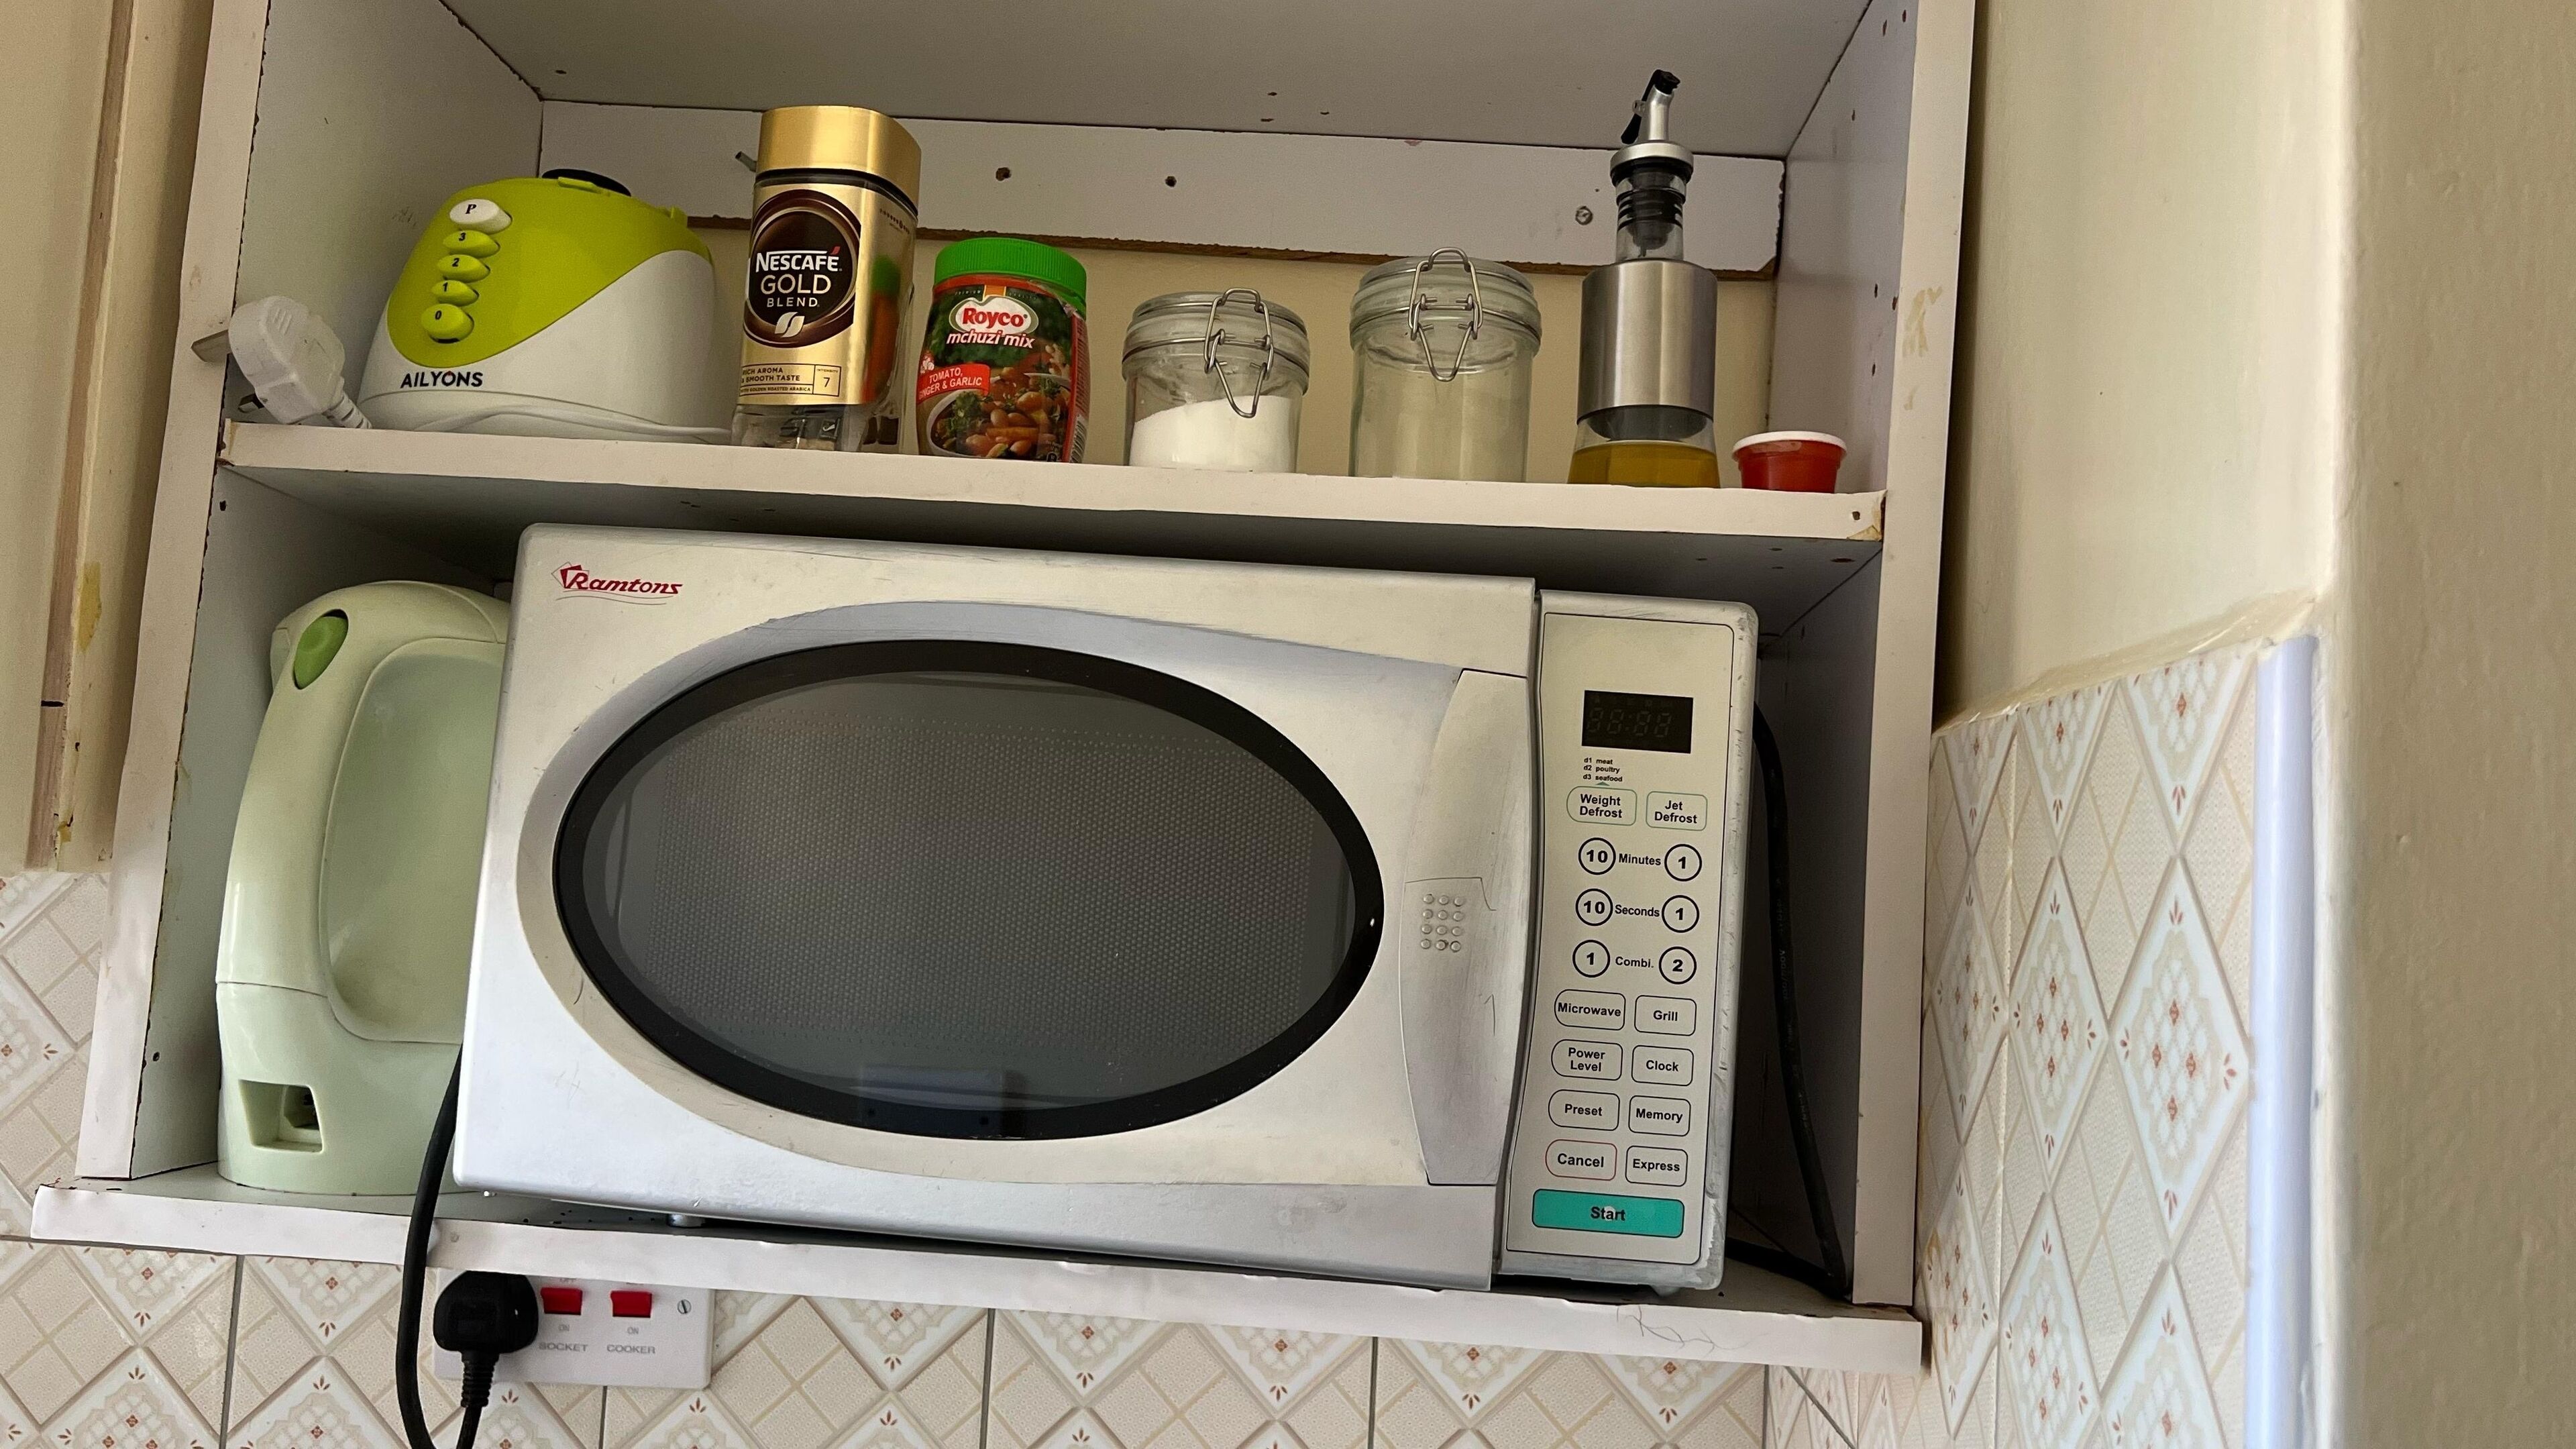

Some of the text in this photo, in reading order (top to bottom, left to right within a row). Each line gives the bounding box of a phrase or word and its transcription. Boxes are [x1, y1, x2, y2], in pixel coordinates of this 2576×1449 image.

[466, 204, 477, 215] P
[458, 232, 466, 241] 3
[452, 258, 460, 267] 2
[442, 282, 448, 292] 1
[761, 274, 832, 294] GOLD
[767, 297, 818, 307] BLEND
[962, 307, 1025, 329] Royco
[946, 329, 1035, 349] mchuzi mix
[400, 371, 484, 388] AILYONS
[929, 368, 963, 384] TOMATO,
[823, 377, 830, 388] 7
[942, 380, 947, 389] &
[950, 377, 982, 387] GARLIC
[564, 572, 683, 594] Ramtons
[1595, 766, 1620, 774] poultry
[1580, 794, 1621, 807] Weight
[1665, 800, 1683, 810] Jet
[1580, 806, 1622, 818] Defrost
[1655, 812, 1697, 824] Defrost
[1586, 850, 1686, 869] 10 Minutes 1
[1583, 901, 1684, 920] 10 Seconds 1
[1587, 953, 1683, 972] 1 Combi. 2
[1558, 1003, 1621, 1017] Microwave
[1653, 1010, 1678, 1021] Grill
[1568, 1048, 1606, 1059] Power
[1570, 1060, 1601, 1071] Level
[1646, 1060, 1679, 1071] Clock
[1564, 1104, 1603, 1116] Preset
[1636, 1108, 1683, 1123] Memory
[1557, 1153, 1604, 1167] Cancel
[1633, 1159, 1680, 1171] Express
[1591, 1206, 1626, 1221] Start
[539, 1342, 588, 1351] SOCKET
[606, 1344, 655, 1354] COOKER
